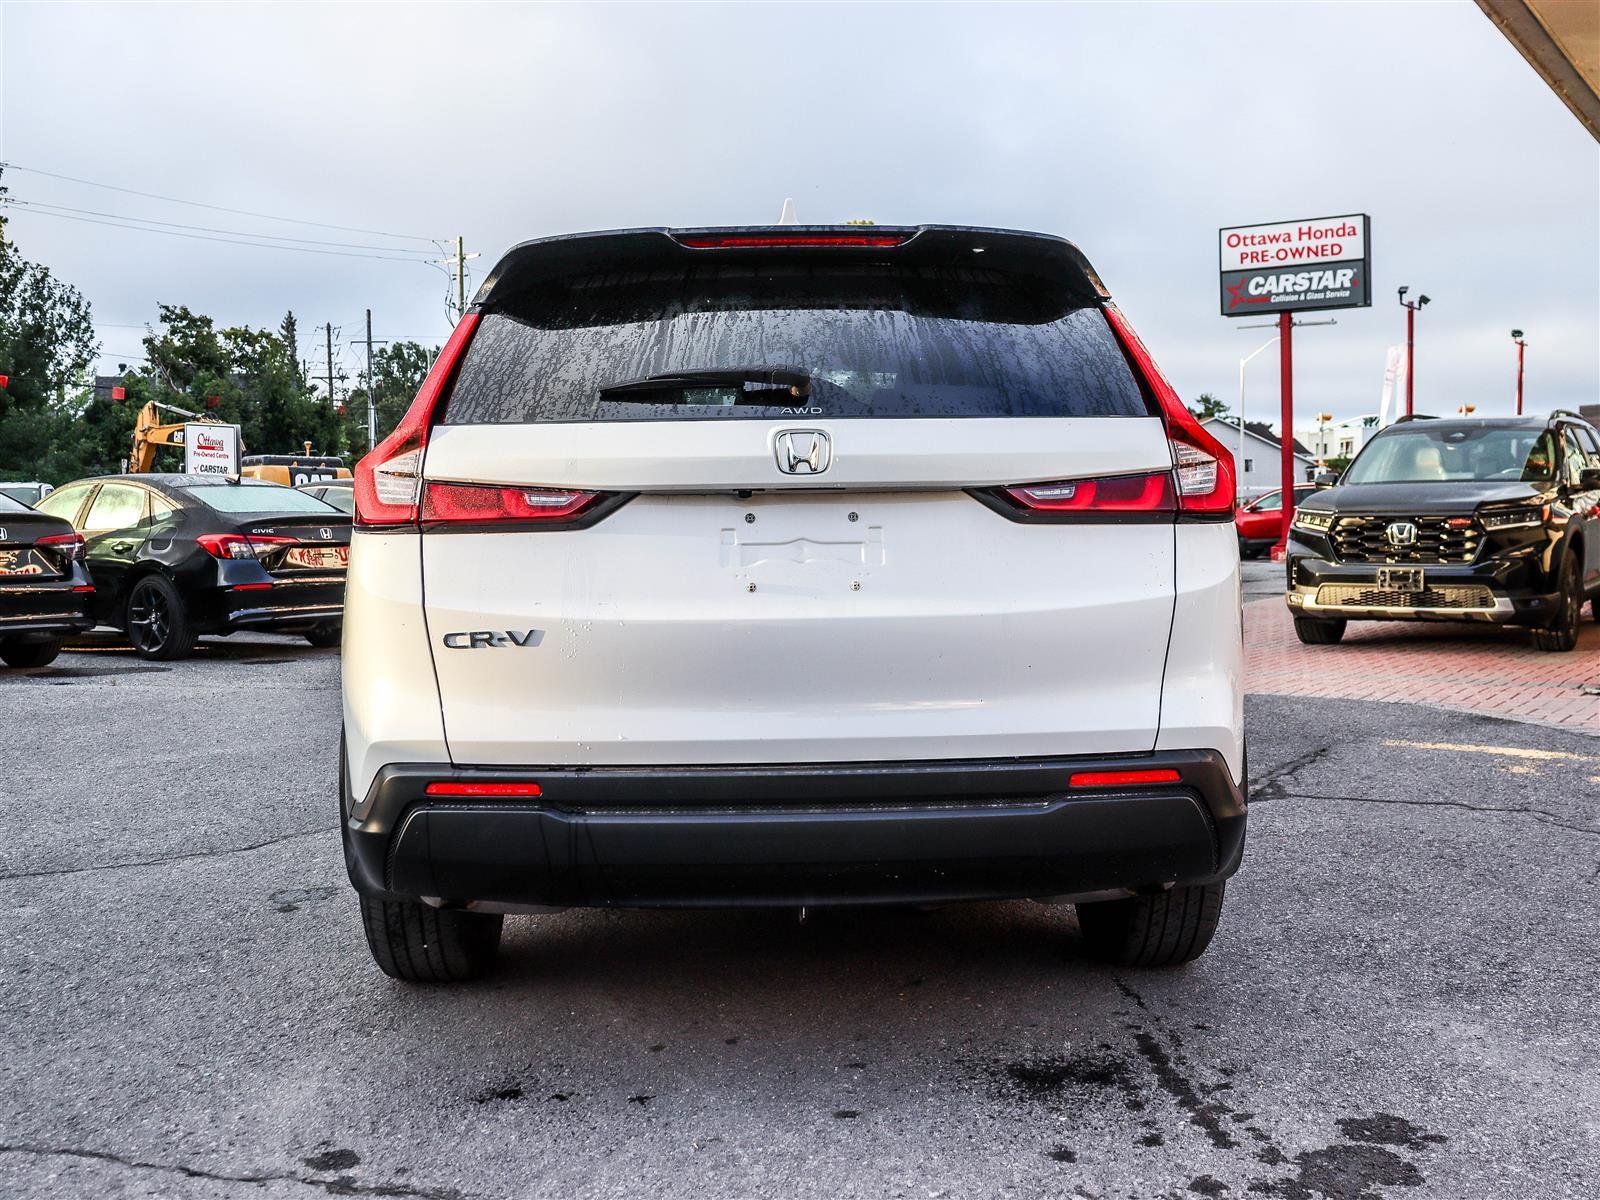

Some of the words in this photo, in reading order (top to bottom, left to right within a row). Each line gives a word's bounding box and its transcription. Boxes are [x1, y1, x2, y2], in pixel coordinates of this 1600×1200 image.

[1227, 232, 1292, 247] Ottawa
[1298, 222, 1357, 241] Honda
[1240, 243, 1343, 264] PRE-OWNED
[1248, 268, 1353, 295] CARSTAR
[1270, 294, 1299, 303] Collision
[1306, 292, 1325, 300] Glass
[1326, 290, 1350, 298] Service
[197, 433, 224, 446] Ottawa
[200, 464, 228, 474] CARSTAR
[443, 629, 546, 649] CR-V
